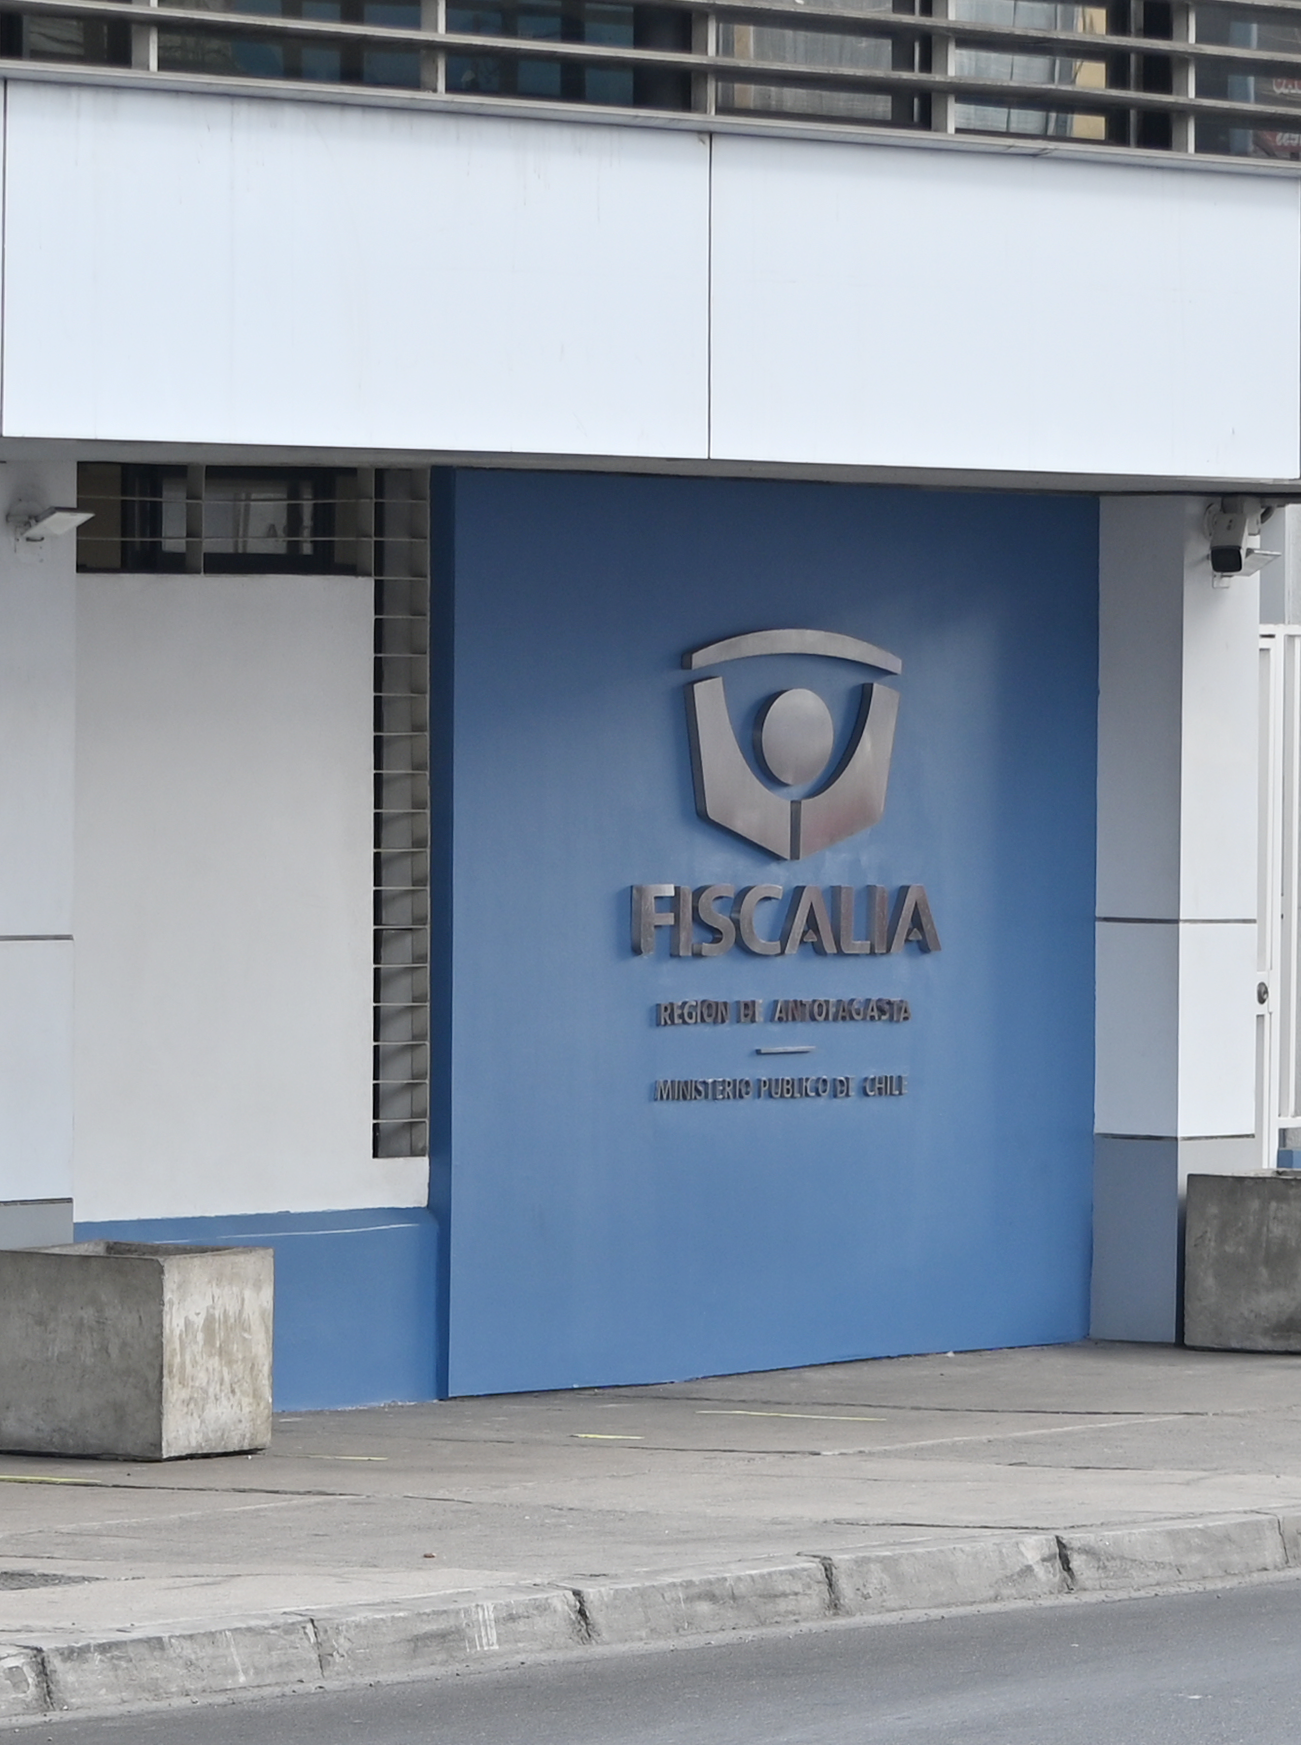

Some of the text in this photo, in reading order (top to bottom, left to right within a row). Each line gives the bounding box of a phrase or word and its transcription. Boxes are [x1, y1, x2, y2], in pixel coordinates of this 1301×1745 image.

[631, 883, 942, 957] FISCALIA
[656, 997, 911, 1026] REGION DE ANTOFAGASTA
[655, 1075, 909, 1101] MINISTERIO PUBLICO DE CHILE
